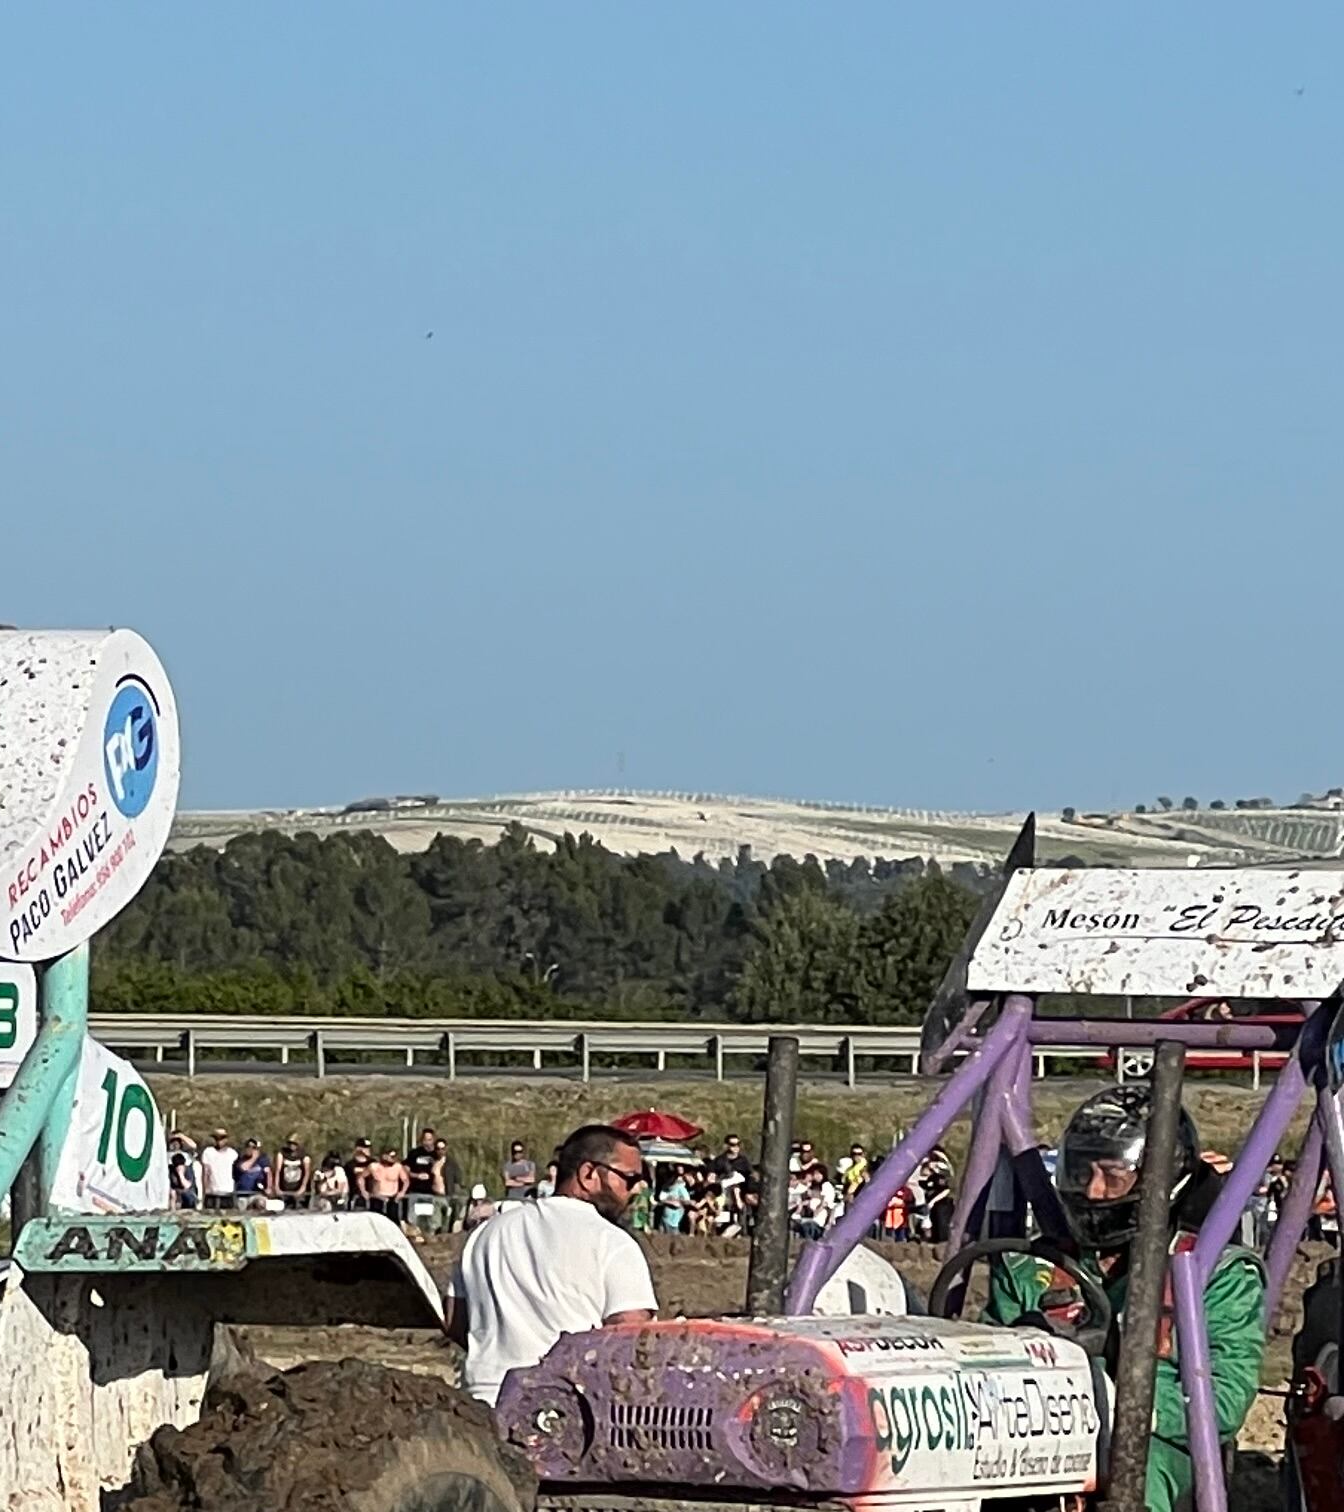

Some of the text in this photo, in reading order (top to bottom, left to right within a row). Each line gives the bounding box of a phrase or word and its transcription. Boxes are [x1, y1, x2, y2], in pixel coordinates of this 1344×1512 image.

[8, 783, 98, 911] RECAMBIOS
[9, 811, 113, 954] PACO GALVEZ
[97, 1068, 154, 1182] 10
[44, 1226, 212, 1261] ANA
